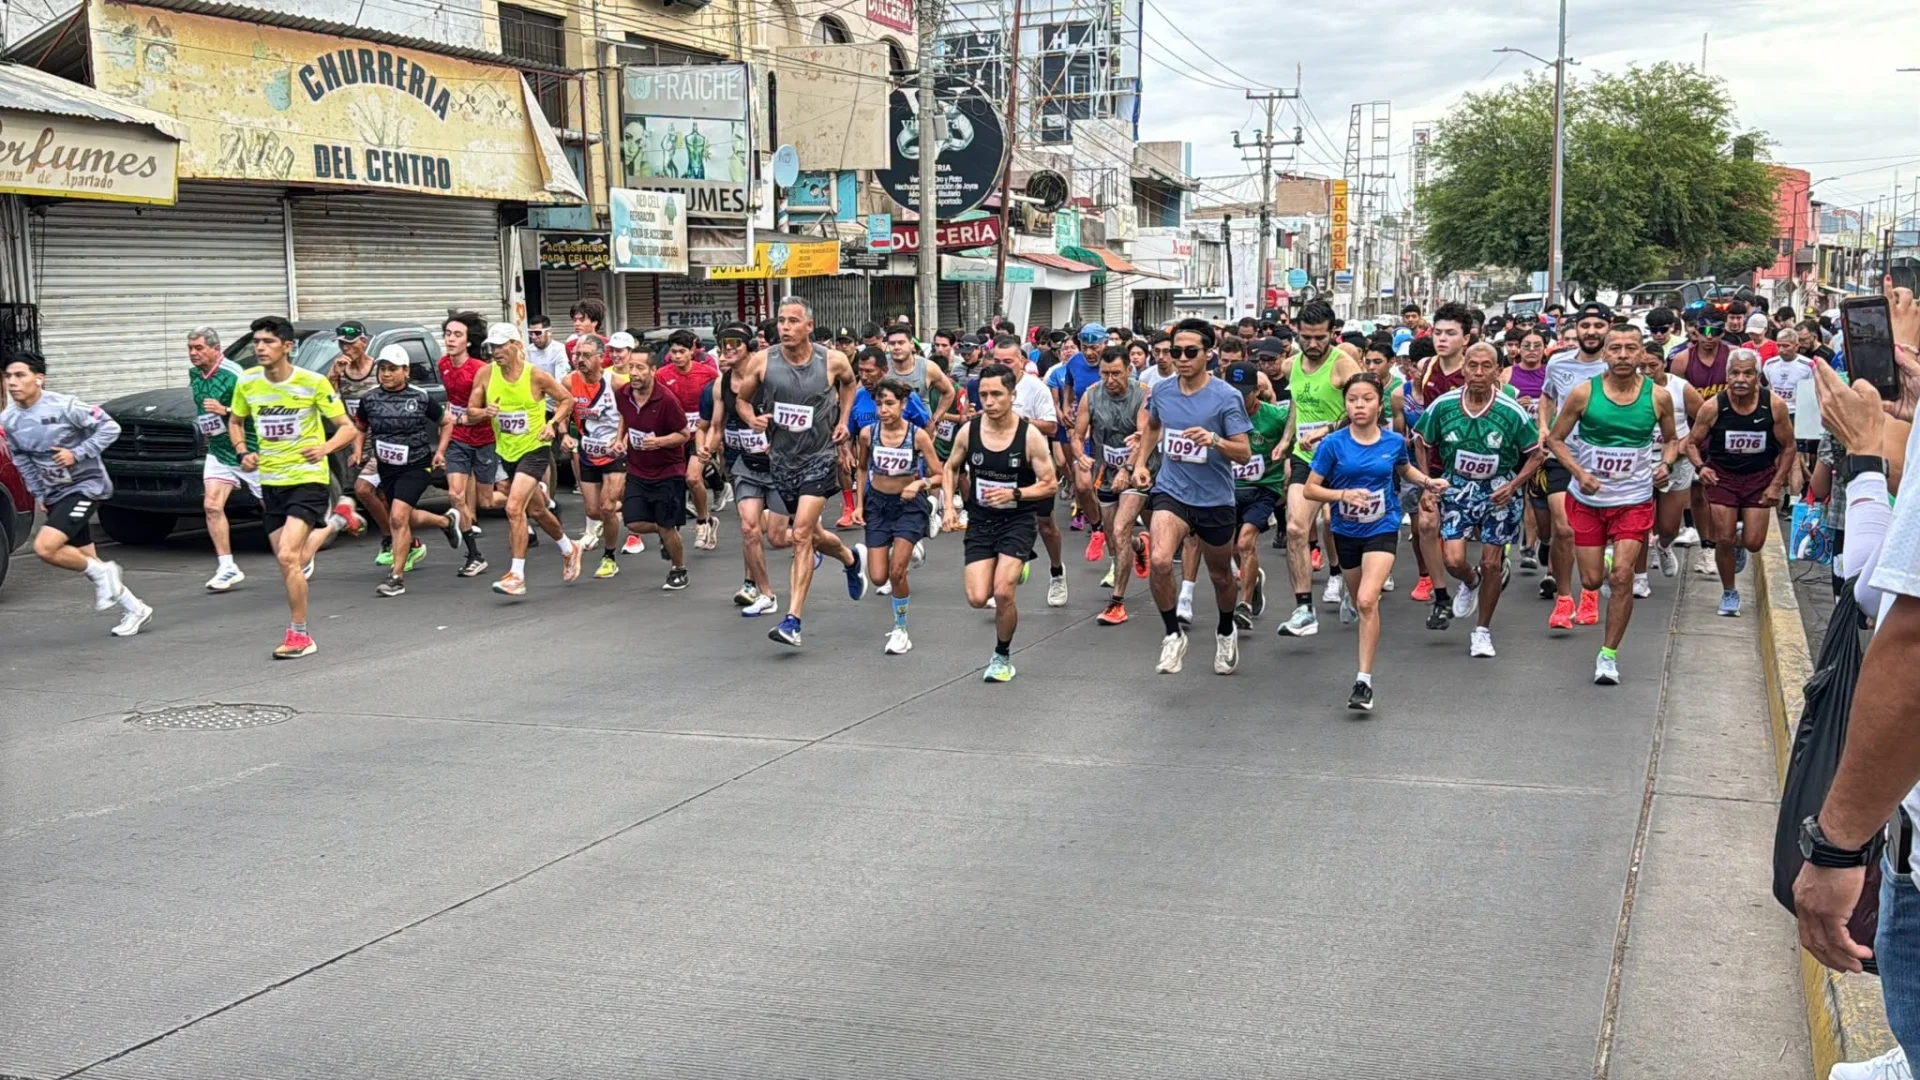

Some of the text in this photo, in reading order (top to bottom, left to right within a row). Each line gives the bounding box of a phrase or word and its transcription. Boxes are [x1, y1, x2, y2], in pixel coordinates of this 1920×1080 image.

[299, 48, 451, 121] CHURRERIA
[654, 71, 743, 101] FRAICHE
[0, 121, 158, 178] erfumes
[313, 144, 357, 180] DEL
[366, 149, 452, 190] CENTRO
[37, 170, 52, 185] de
[60, 171, 114, 189] Apartado
[628, 186, 745, 214] UMES
[648, 195, 660, 209] CELL
[891, 222, 997, 250] DUCERÍA
[1333, 197, 1345, 269] Kodak
[542, 254, 566, 263] PARA
[1233, 368, 1244, 382] S
[201, 420, 221, 432] 1025
[499, 419, 526, 430] 1079
[778, 412, 808, 427] 1176
[264, 423, 295, 437] 1135
[583, 443, 608, 455] 1286
[1167, 439, 1203, 457] 1097
[1729, 438, 1761, 449] 1016
[379, 448, 404, 462] 1326
[875, 456, 909, 470] 1270
[1232, 463, 1261, 478] 1221
[1459, 459, 1494, 474] 1081
[1596, 456, 1633, 473] 1012
[1342, 500, 1381, 516] 1247
